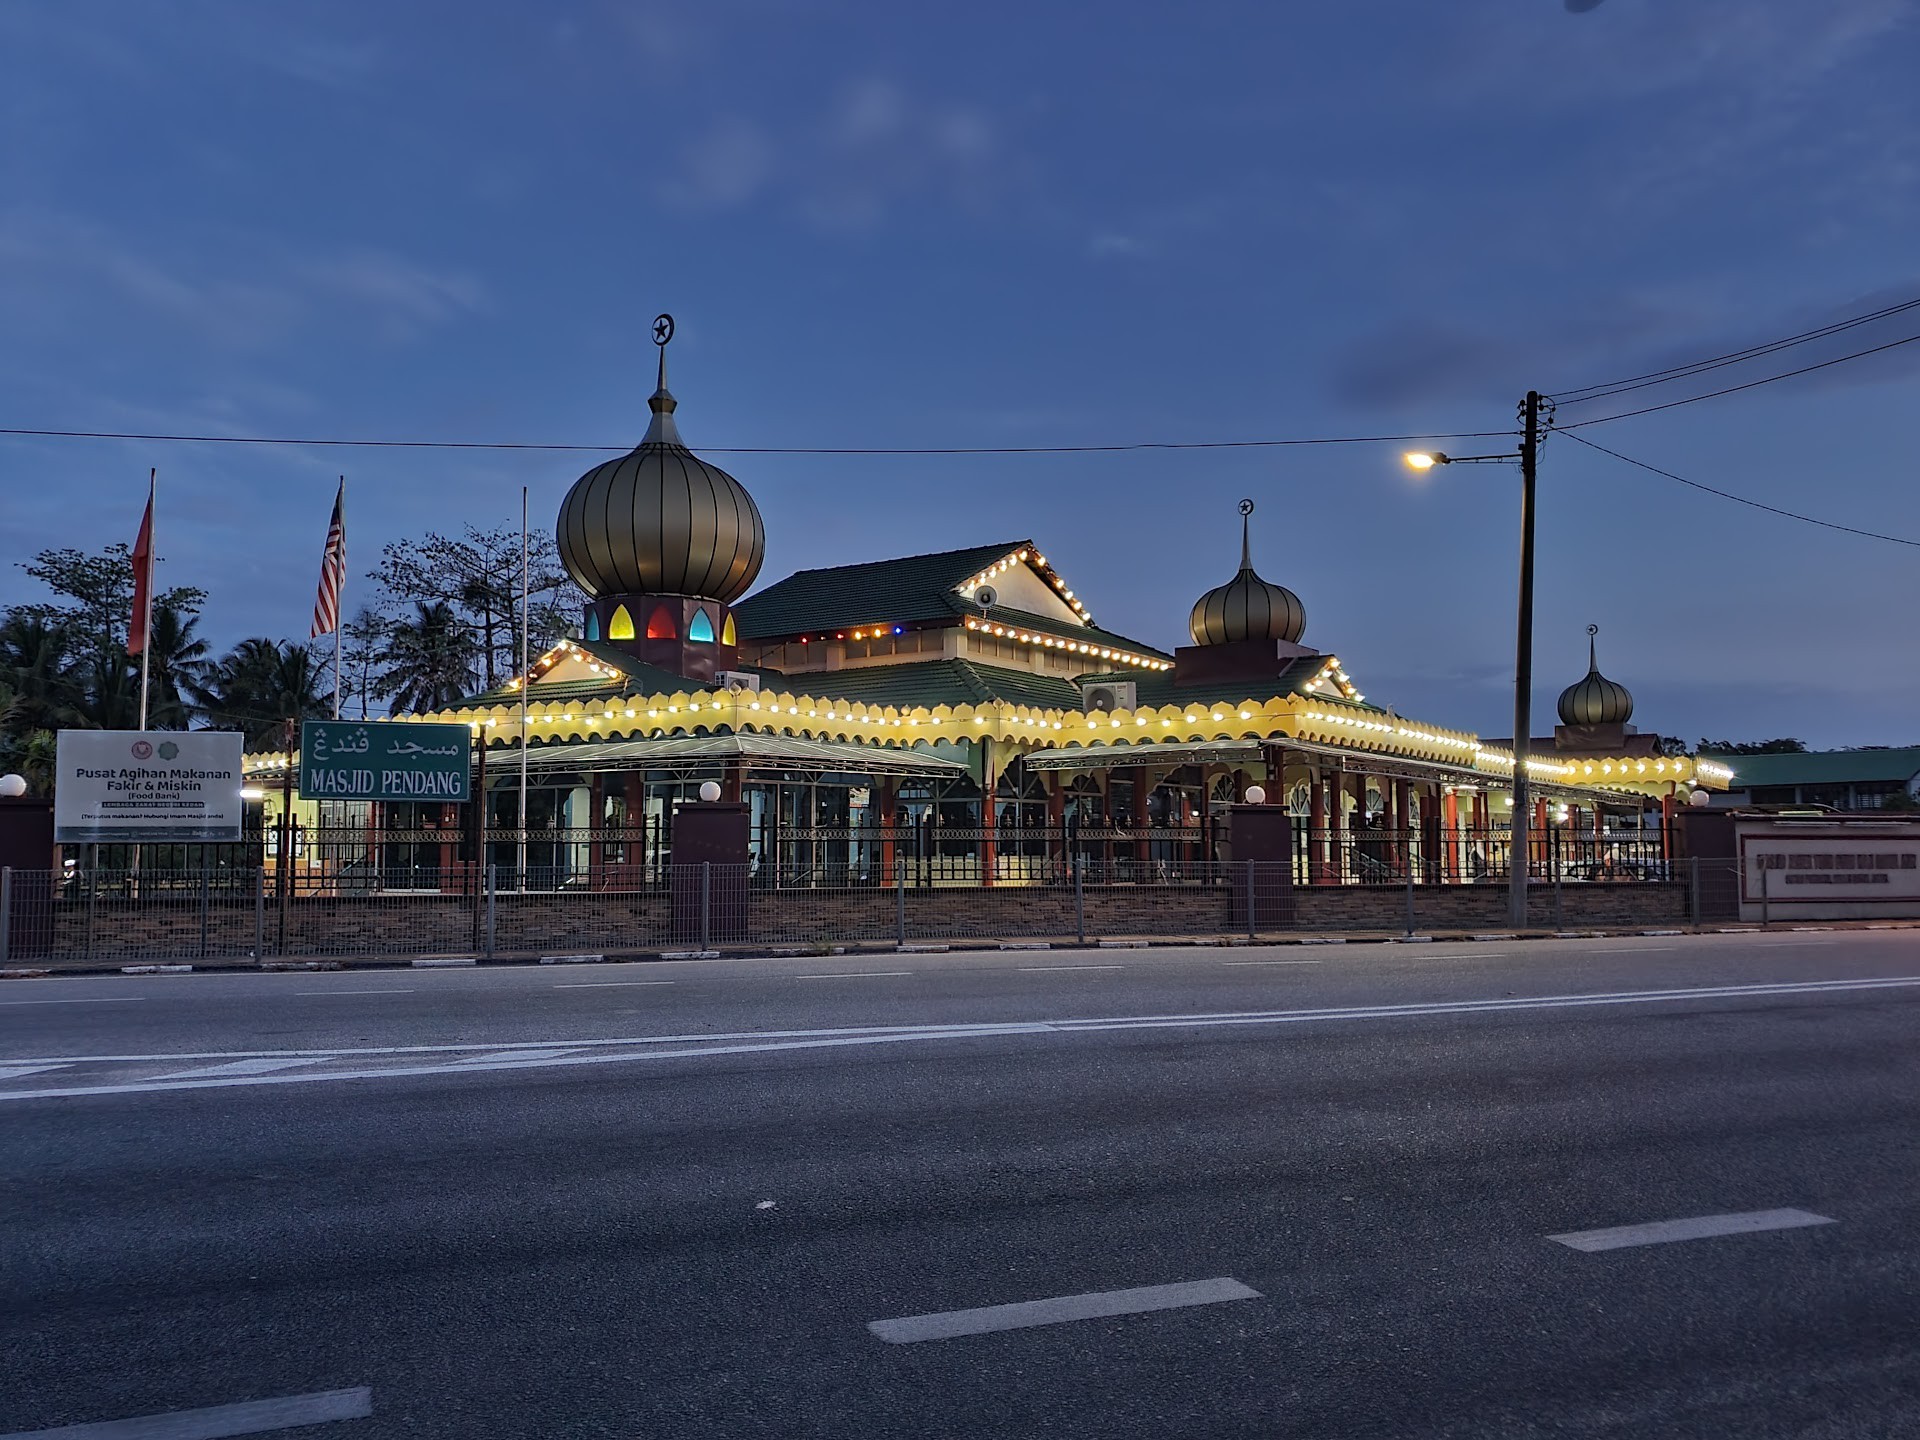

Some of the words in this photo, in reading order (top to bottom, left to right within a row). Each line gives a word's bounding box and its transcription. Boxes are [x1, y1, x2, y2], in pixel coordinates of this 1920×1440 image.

[387, 740, 459, 760] مسجد
[76, 768, 116, 778] Pusat
[119, 768, 167, 781] Agihan
[170, 769, 231, 779] Makanan
[107, 780, 141, 791] Fakir
[144, 781, 154, 791] &
[157, 780, 202, 791] Miskin
[310, 769, 374, 794] MASJID
[381, 769, 461, 795] PENDANG
[128, 792, 153, 800] (Food
[155, 792, 180, 800] Bank)
